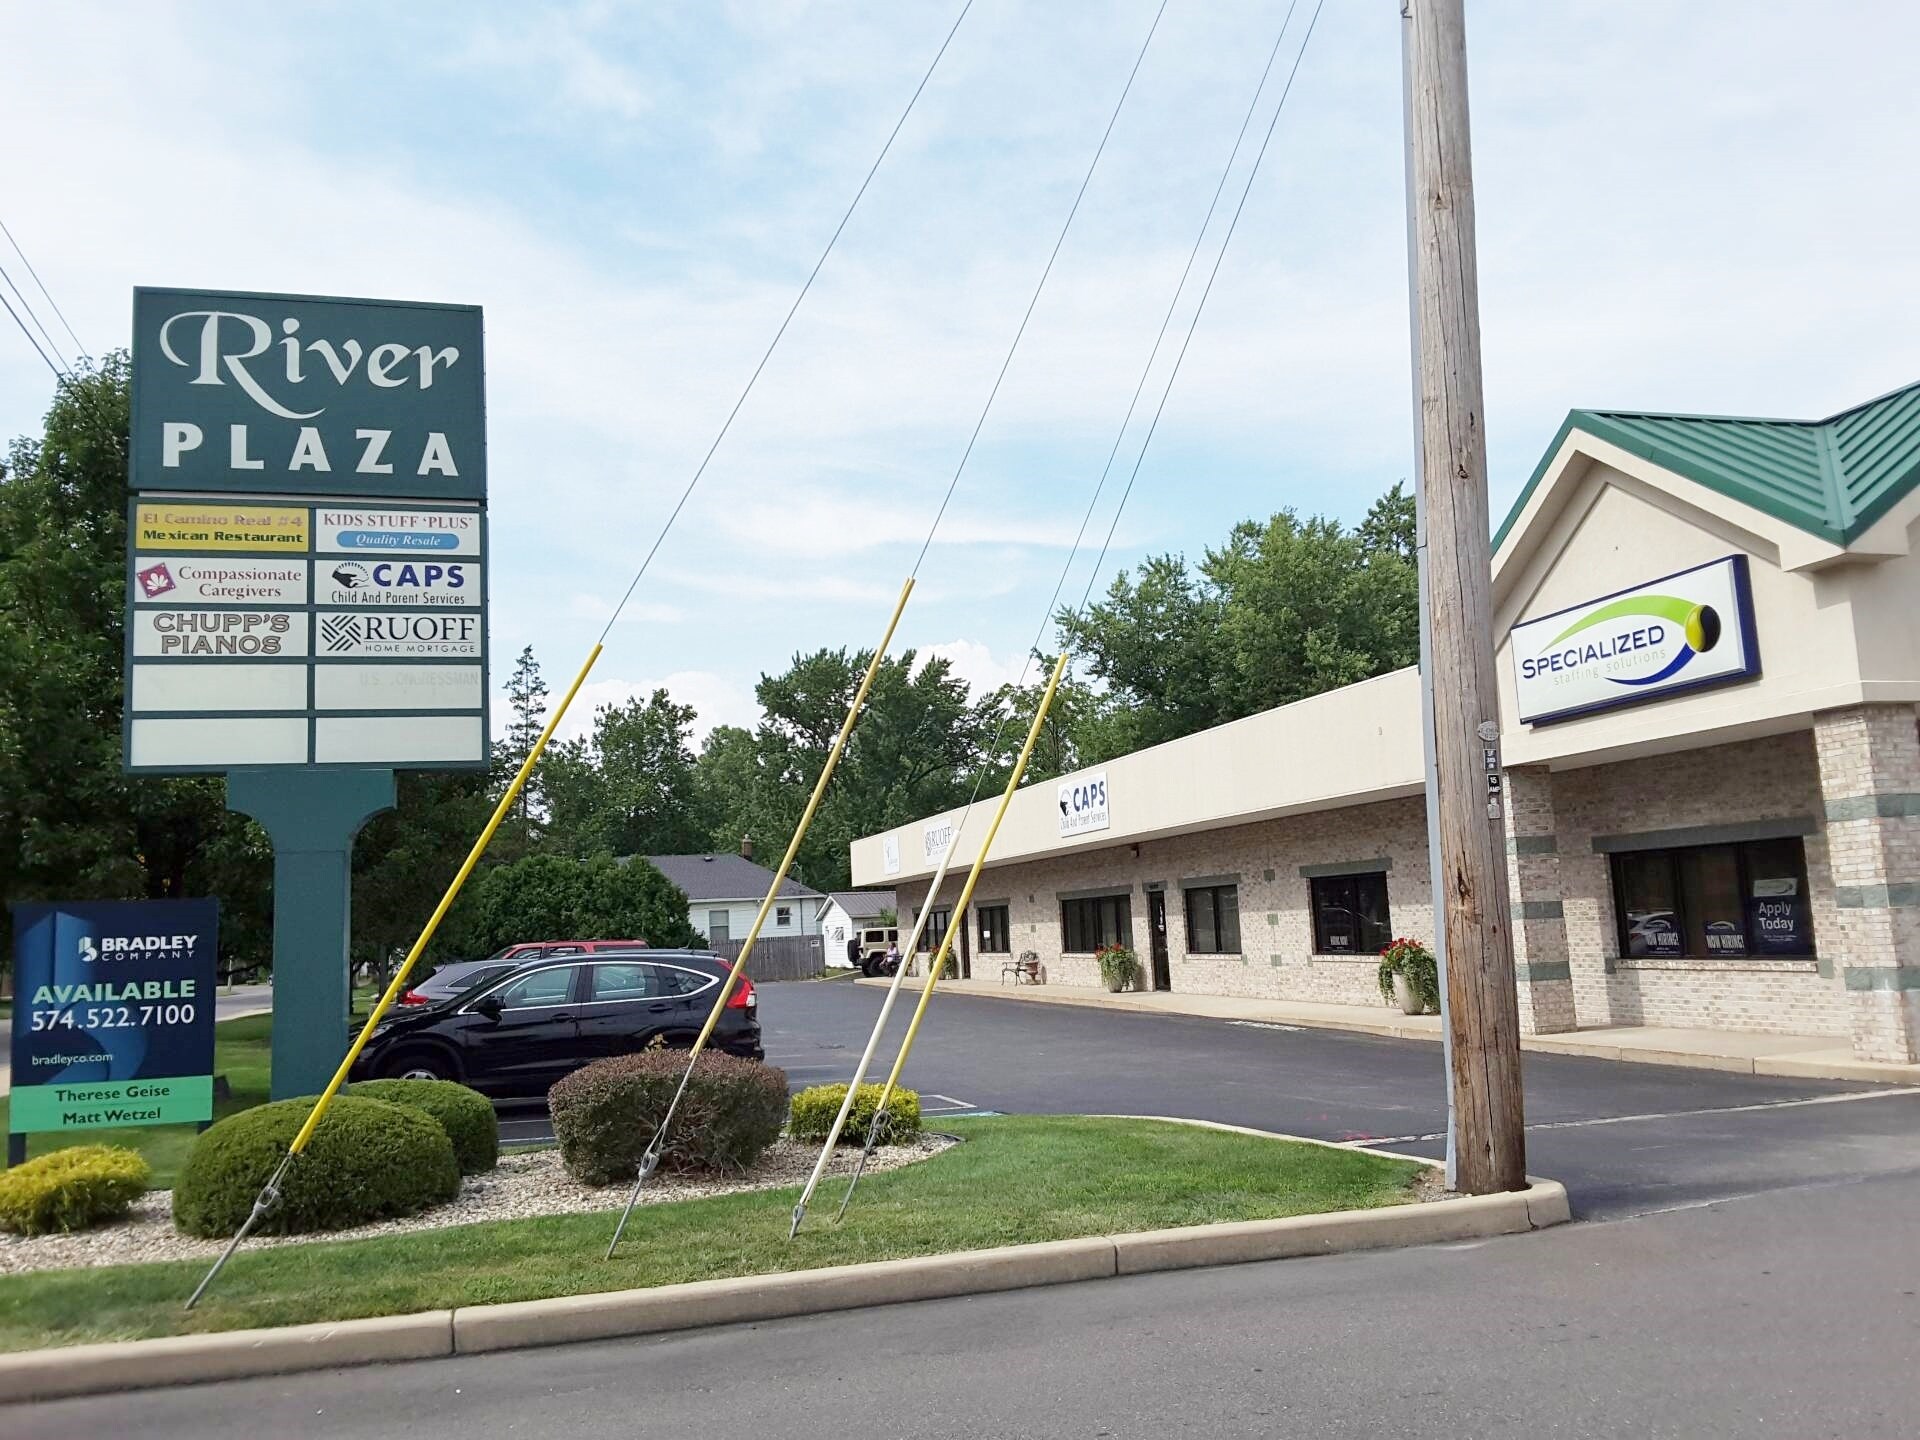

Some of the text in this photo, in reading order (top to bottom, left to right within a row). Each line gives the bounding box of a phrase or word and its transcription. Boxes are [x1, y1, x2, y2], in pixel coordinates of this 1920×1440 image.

[159, 310, 460, 419] River
[162, 422, 459, 477] PLAZA
[143, 513, 303, 527] El Camino Real #4
[324, 513, 363, 526] KIDS
[367, 515, 419, 528] STUFF
[143, 530, 304, 543] Mexican Restaurant
[356, 533, 441, 546] Quality Resale
[178, 566, 302, 583] Compassionate
[372, 563, 465, 589] CAPS
[199, 583, 282, 600] Caregivers
[331, 590, 465, 605] Child And Parent Services
[153, 612, 290, 633] CHUPP'S
[364, 616, 475, 641] RUOFF
[161, 635, 282, 654] PIANOS
[365, 644, 476, 653] HOME MORTGAGE
[1522, 625, 1665, 680] SPECIALIZED
[1553, 649, 1667, 686] staffing solutions
[1073, 781, 1106, 812] CAPS
[1090, 810, 1107, 824] Services
[931, 826, 951, 847] RUOFF
[1758, 901, 1792, 917] Apply
[1758, 917, 1794, 931] Today
[101, 935, 198, 952] BRADLEY
[101, 951, 195, 961] COMPANY
[32, 980, 196, 1005] AVAILABLE
[31, 1004, 195, 1031] 574.522.7100
[32, 1052, 113, 1066] bradleyco.com
[55, 1085, 170, 1102] Therese Geise
[63, 1107, 161, 1125] Matt Wetzel
